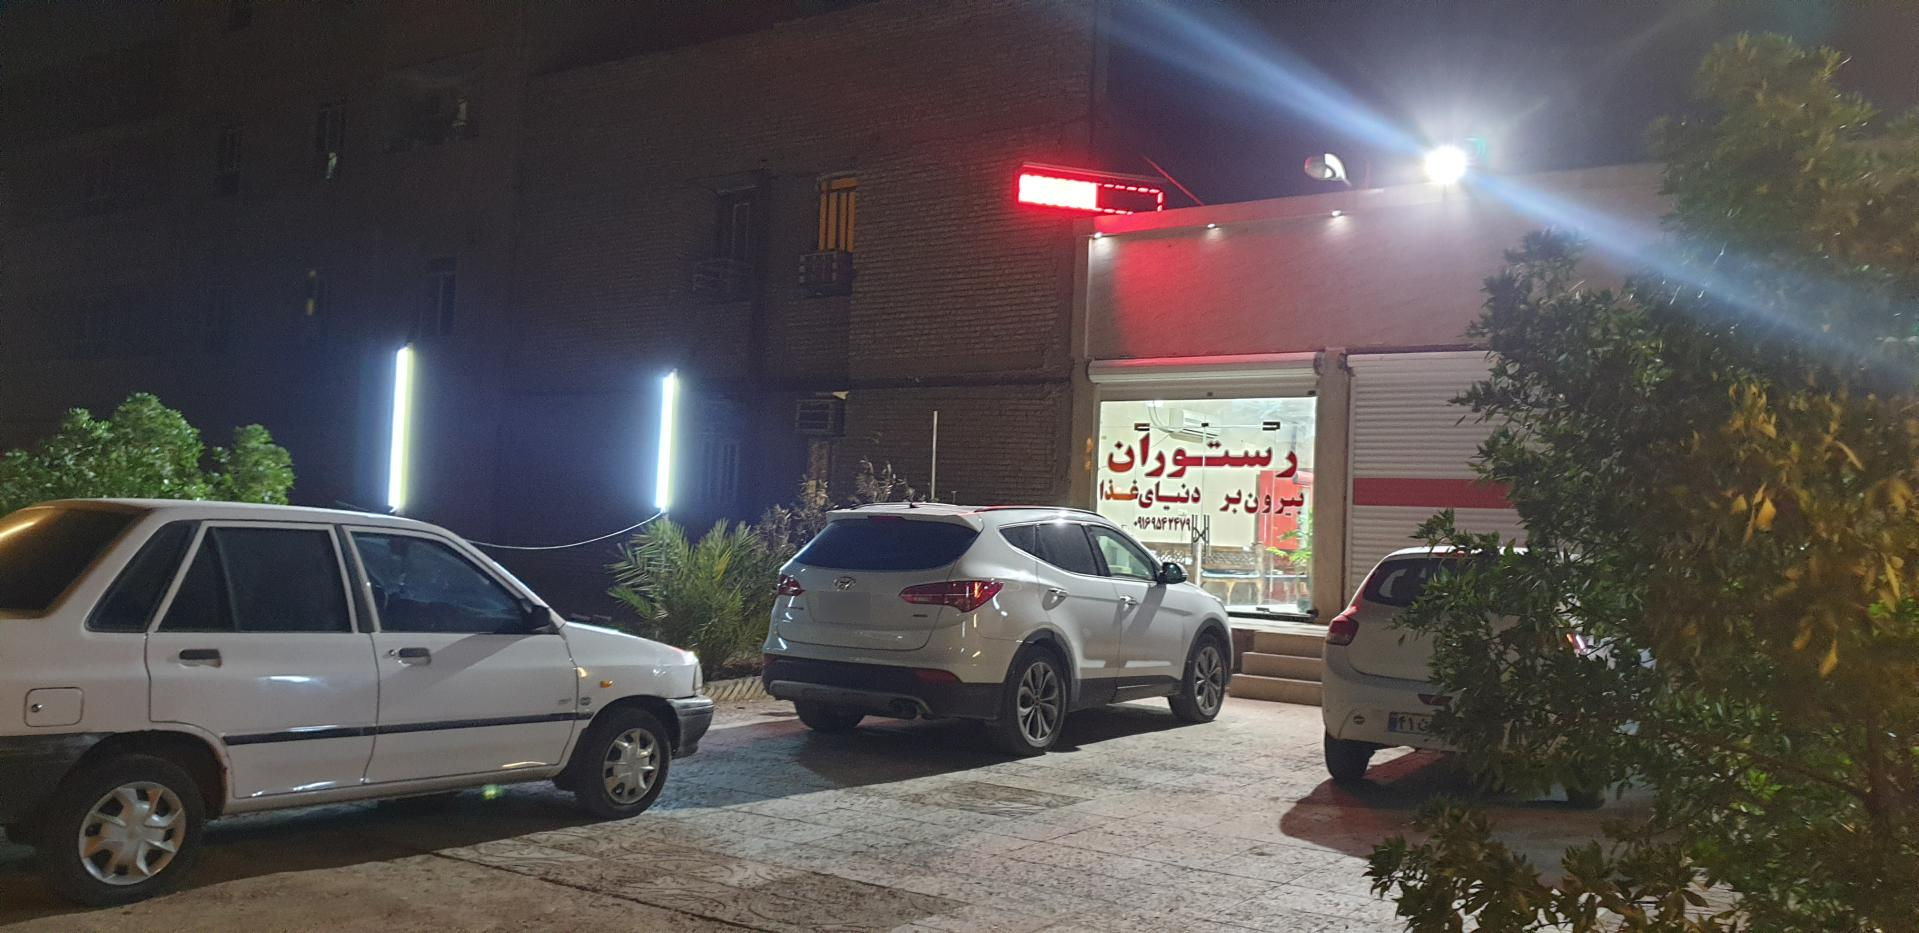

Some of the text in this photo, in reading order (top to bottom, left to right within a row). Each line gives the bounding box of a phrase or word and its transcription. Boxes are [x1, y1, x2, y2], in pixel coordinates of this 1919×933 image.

[1107, 432, 1297, 477] رستوران
[1099, 478, 1139, 502] غذا
[1138, 480, 1201, 510] دنیای
[1243, 488, 1305, 515] بیرون
